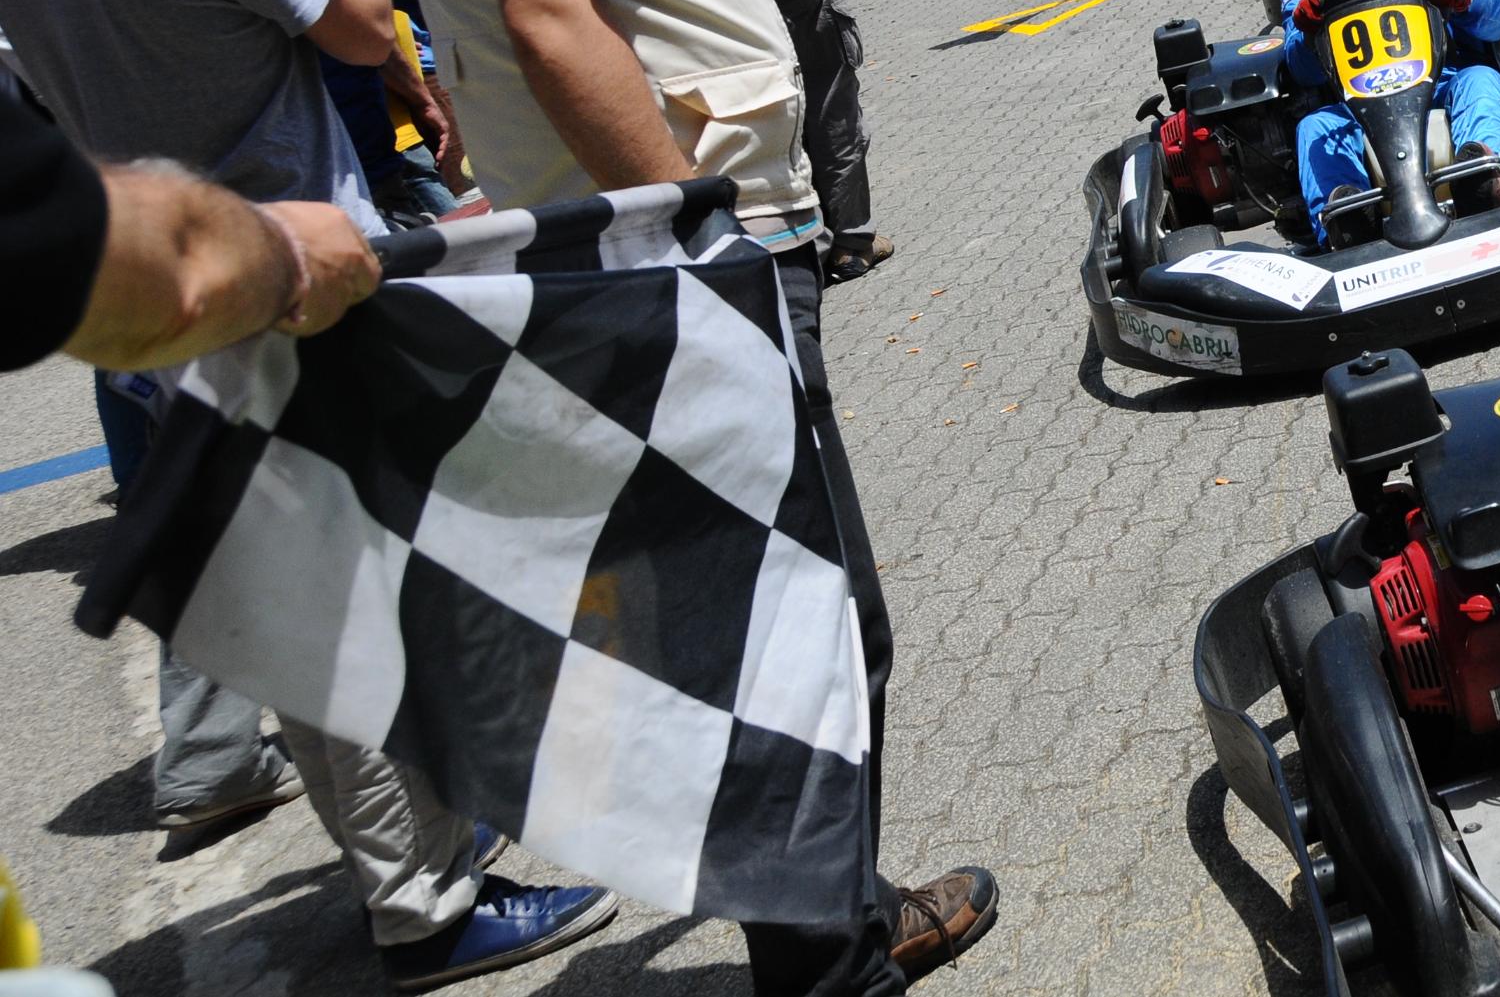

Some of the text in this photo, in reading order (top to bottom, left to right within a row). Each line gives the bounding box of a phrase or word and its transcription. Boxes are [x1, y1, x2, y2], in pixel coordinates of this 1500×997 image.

[1341, 9, 1412, 70] 99
[1342, 260, 1422, 293] UNITRIP
[1119, 313, 1236, 362] HIDROCABRIL
